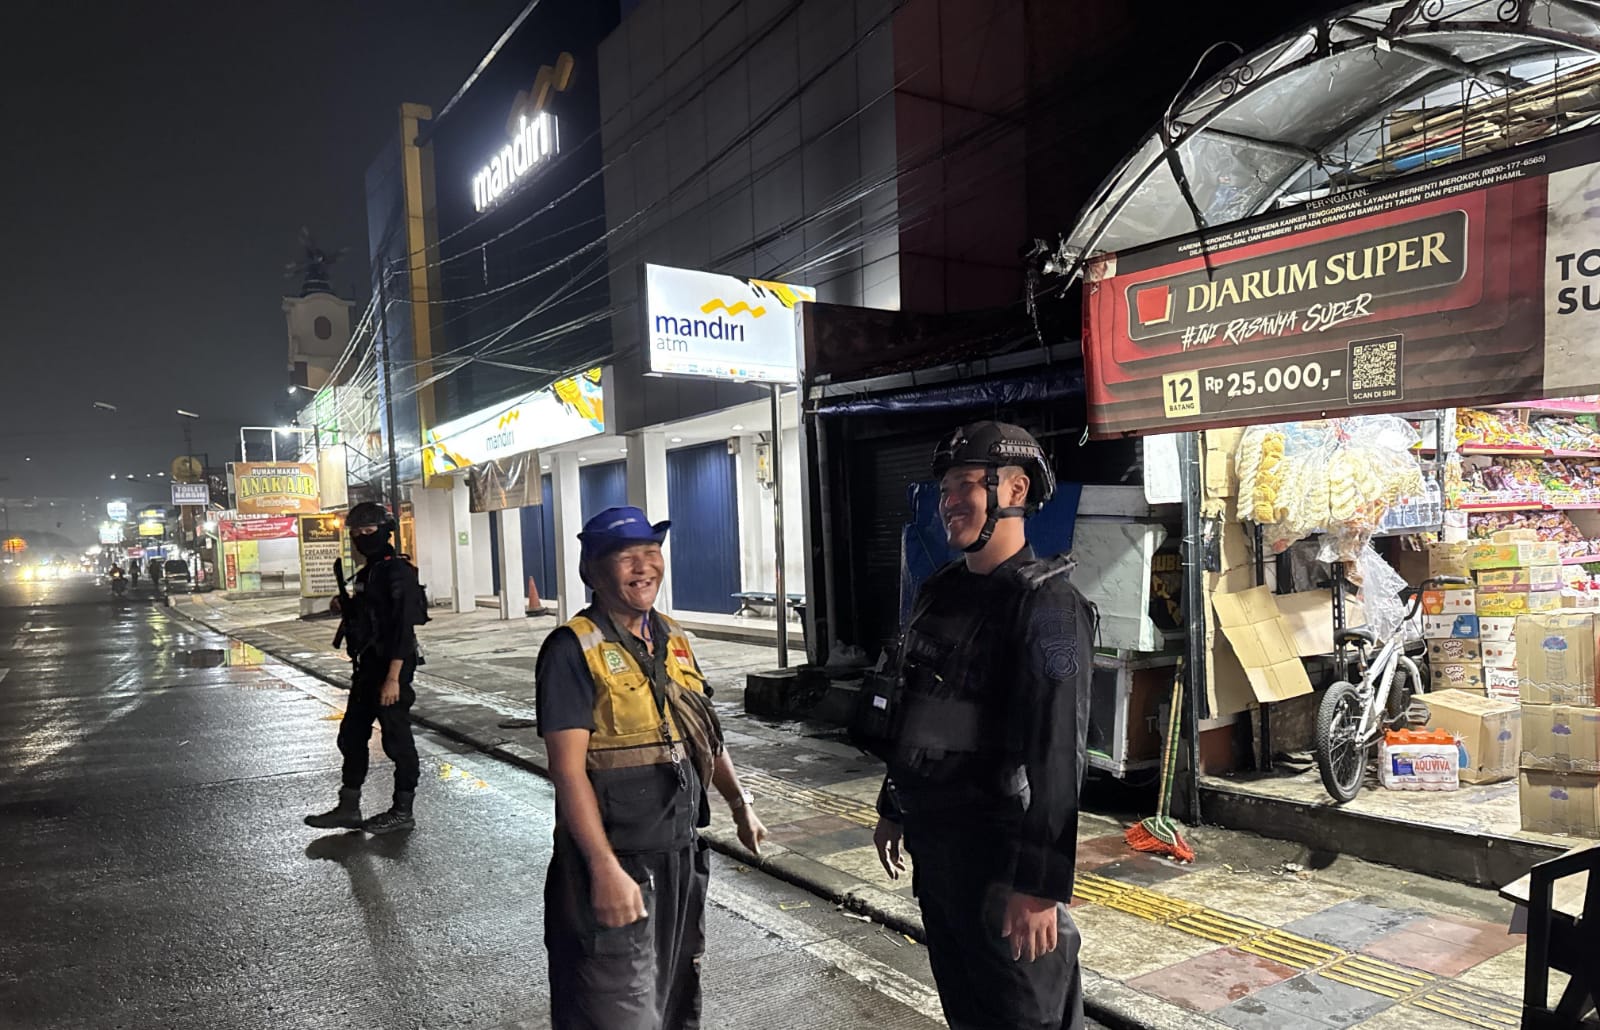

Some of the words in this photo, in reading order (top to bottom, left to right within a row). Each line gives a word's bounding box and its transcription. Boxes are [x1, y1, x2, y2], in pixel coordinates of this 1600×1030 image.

[473, 110, 559, 211] mandiri
[1233, 230, 1250, 240] SAYA
[1250, 221, 1279, 235] TERKENA
[1279, 215, 1307, 227] KANKER
[1363, 191, 1398, 206] LAYANAN
[1399, 181, 1438, 197] BERHENTI
[1438, 172, 1480, 187] MEROKOK
[1482, 154, 1547, 178] (0800-177-6565)
[1218, 237, 1247, 250] MENJUAL
[1247, 233, 1262, 242] DAN
[1262, 227, 1292, 240] MEMBERI
[1294, 219, 1321, 232] KEPADA
[1322, 214, 1347, 225] ORANG
[1348, 210, 1357, 219] DI
[1357, 204, 1384, 216] BAWAH
[1384, 201, 1394, 210] 21
[1394, 194, 1421, 207] TAHUN
[1424, 189, 1442, 200] DAN
[1442, 177, 1495, 196] PEREMPUAN
[1187, 259, 1319, 313] DJARUM
[1323, 231, 1452, 286] SUPER
[655, 315, 745, 342] mandiri
[1181, 324, 1217, 350] #INI
[1222, 310, 1299, 345] RASANYA
[1302, 293, 1375, 333] SUPER
[656, 337, 688, 353] atm
[1168, 377, 1194, 404] 12
[1204, 376, 1224, 394] Rp
[1227, 362, 1342, 397] 25.000,-
[1353, 391, 1373, 400] SCAN
[1374, 391, 1382, 399] DI
[1382, 389, 1397, 398] SINI
[1169, 403, 1195, 412] BATANG
[252, 468, 275, 476] RUMAH
[240, 476, 282, 497] ANAK
[286, 475, 315, 497] AIR
[1414, 759, 1451, 772] AQUVIVA
